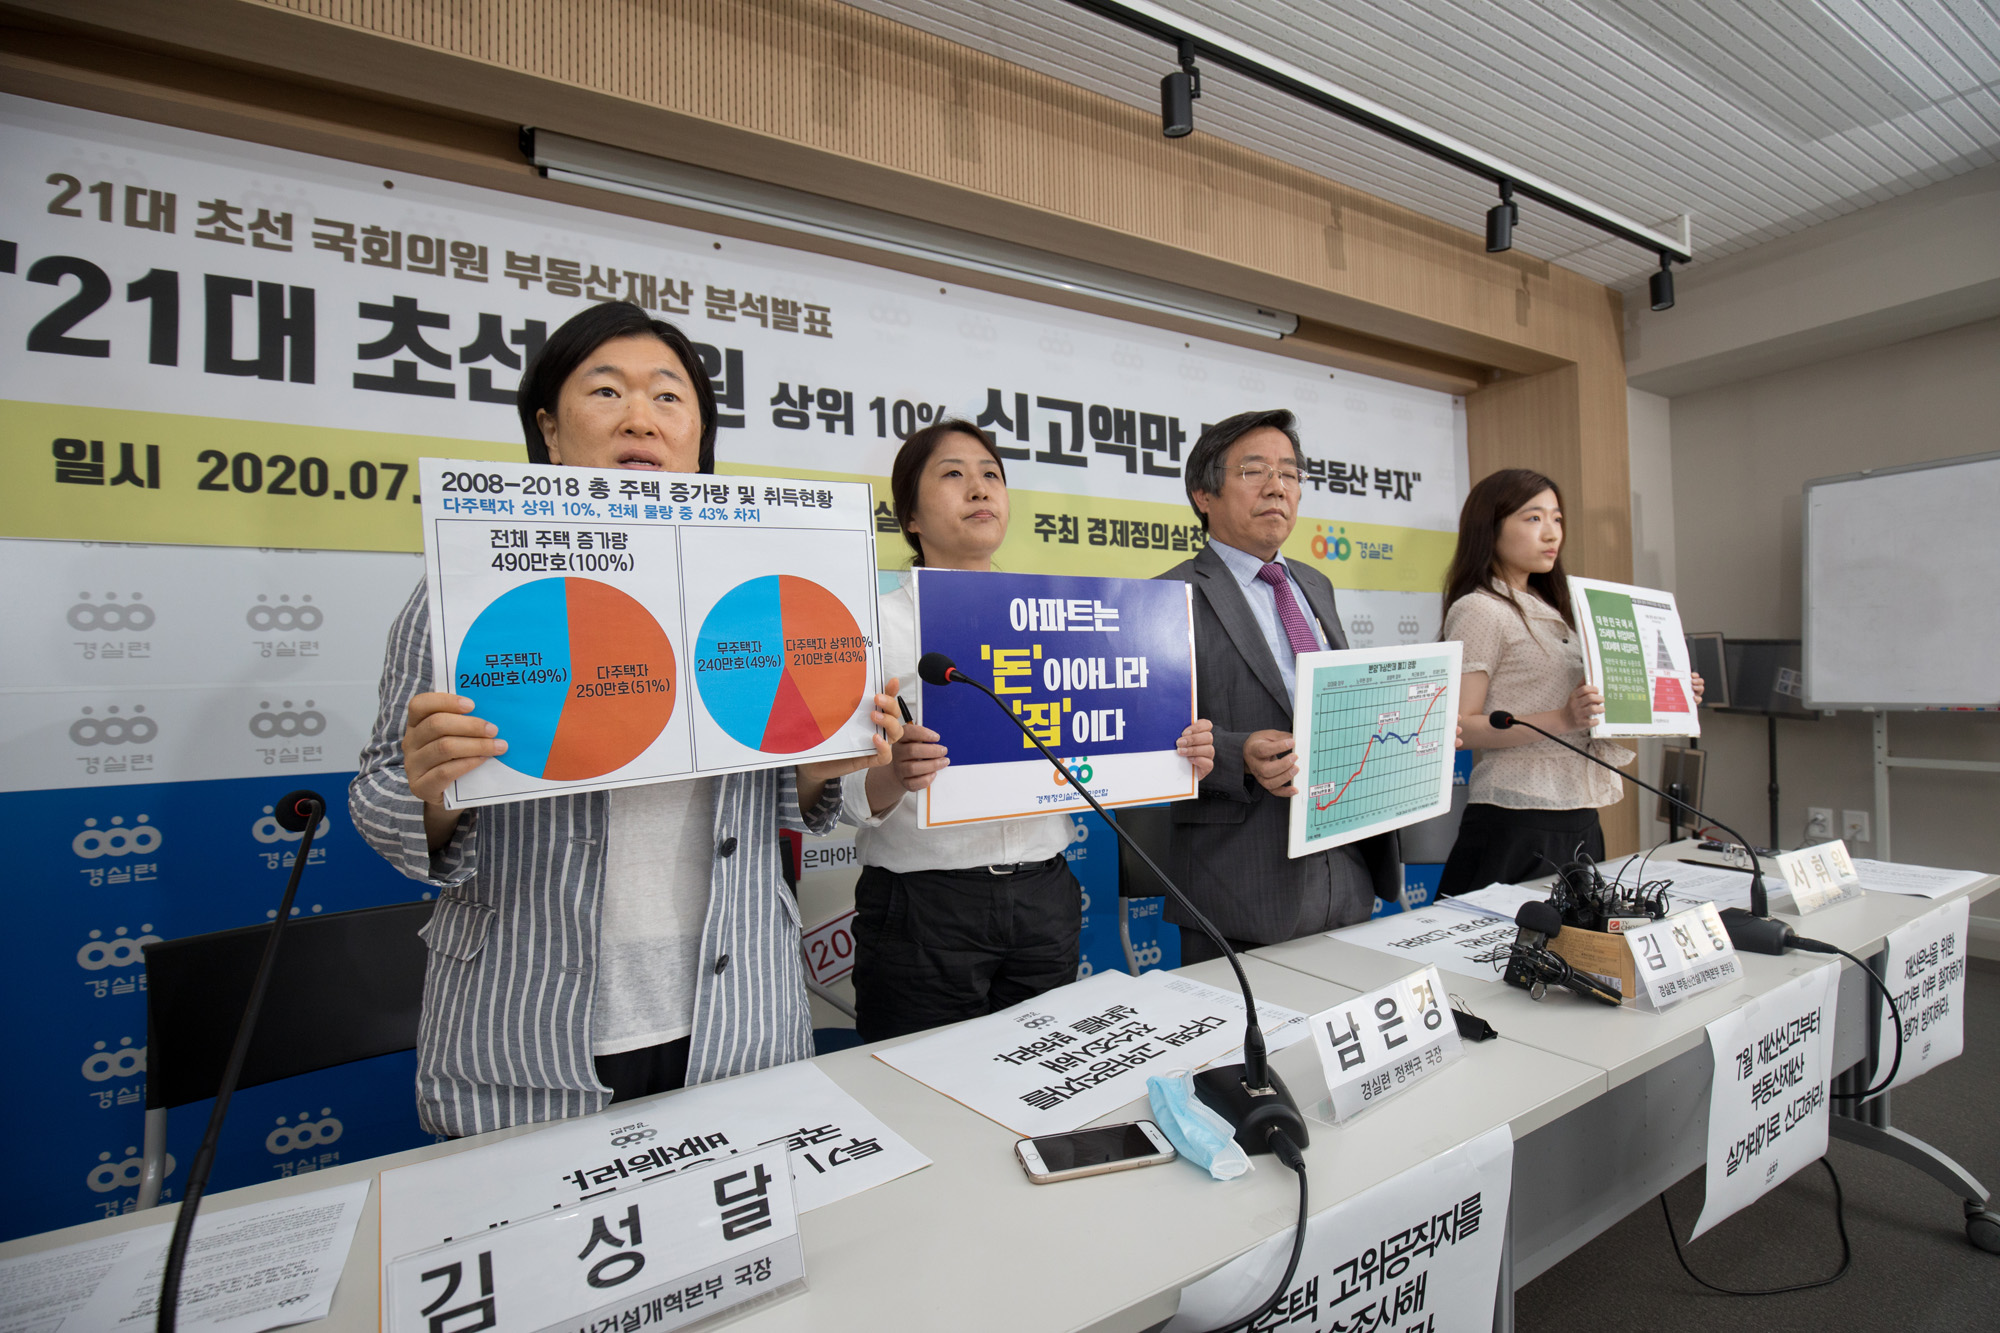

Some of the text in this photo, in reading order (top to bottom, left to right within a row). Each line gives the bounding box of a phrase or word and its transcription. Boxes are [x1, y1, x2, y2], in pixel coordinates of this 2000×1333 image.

[45, 171, 833, 339] 21대 초선 국회의원 부동산재산 분석발표
[771, 381, 854, 437] 상위
[977, 387, 1187, 479] 신고액만
[1306, 457, 1369, 497] 부동산
[52, 437, 161, 490] 일시
[1034, 513, 1079, 545] 주최
[1356, 540, 1394, 561] 경실련
[441, 471, 834, 510] 2008-2018 총 주택 증가량 및 취득현황
[443, 496, 761, 523] 다주택자 상위 10%, 전체 물량 중 43% 차지
[490, 529, 629, 551] 전체 주택 증가량
[491, 552, 635, 573] 490만호(100%)
[1009, 597, 1120, 632] 아파트는
[73, 641, 152, 660] 경실련
[252, 640, 320, 658] 경실련
[716, 639, 763, 655] 무주택자
[785, 635, 874, 652] 다주택자 상위10%
[485, 652, 543, 668] 무주택자
[596, 663, 649, 681] 다주택자
[697, 653, 782, 673] 240만호(49%)
[793, 650, 868, 668] 210만호(43%)
[459, 666, 568, 690] 240만호(49%)
[575, 678, 671, 699] 250만호(51%)
[76, 754, 154, 774] 경실련
[255, 745, 323, 765] 경실련
[1036, 788, 1109, 804] 경제정의실천민연합
[80, 863, 158, 887] 경실련
[1129, 903, 1159, 919] 경실련
[1638, 933, 1667, 971] 김
[1904, 932, 1955, 980] 재산은닉을 위한
[1658, 980, 1676, 998] 경실련
[1922, 973, 1937, 999] 여부
[1068, 1004, 1140, 1035] 실태를
[1326, 979, 1442, 1072] 남 은 경
[1921, 994, 1950, 1032] 방지하라.
[1038, 1021, 1158, 1074] 전수조사해
[1736, 1006, 1821, 1081] 7월 재산신고부터
[1019, 1015, 1228, 1111] 다주택 고위공직자를
[1361, 1045, 1443, 1101] 경실련 정책국 국장
[1751, 1052, 1805, 1111] 부동산재산
[89, 1085, 147, 1109] 경실
[1726, 1080, 1824, 1177] 실거래가로 신고하라.
[563, 1131, 730, 1192] 배제하라.
[804, 1134, 885, 1174] 투기
[421, 1250, 498, 1333] 김
[577, 1203, 646, 1290] 성
[713, 1163, 773, 1243] 달
[1250, 1191, 1483, 1333] 주택 고위공직자를
[734, 1257, 772, 1286] 국장
